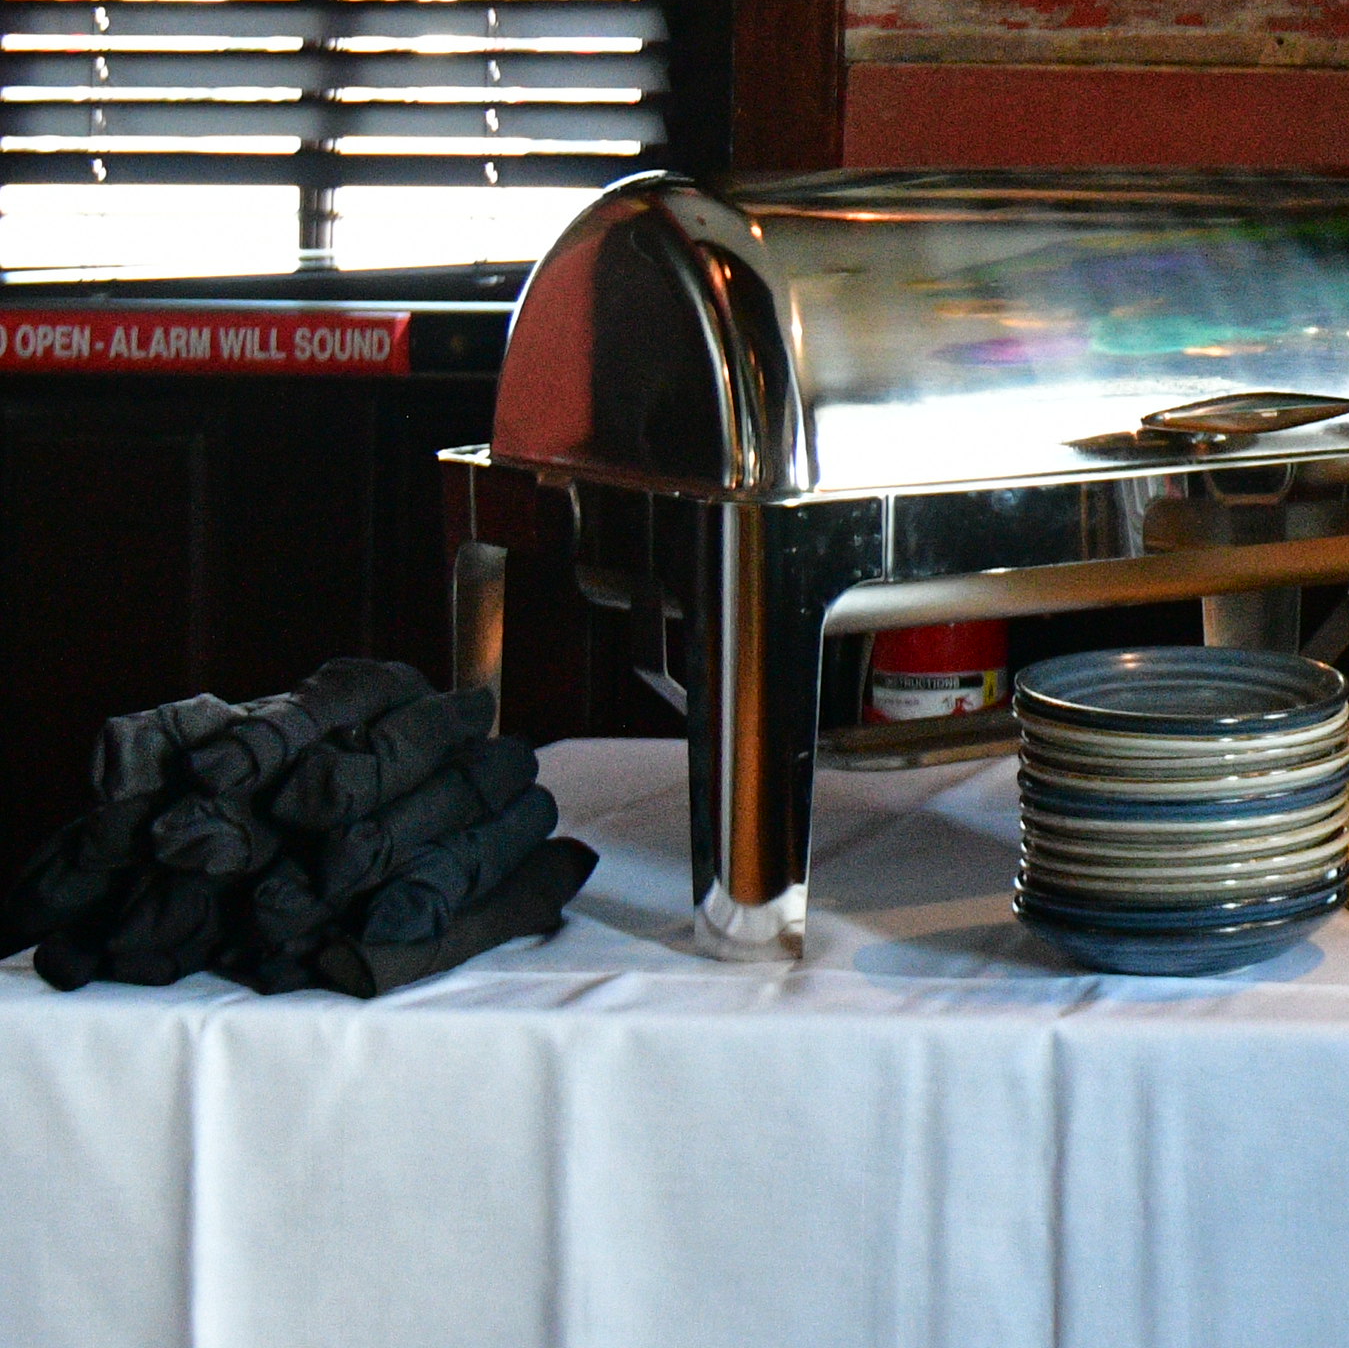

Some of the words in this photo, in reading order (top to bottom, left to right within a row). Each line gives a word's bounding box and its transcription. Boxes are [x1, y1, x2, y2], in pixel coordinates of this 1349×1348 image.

[109, 326, 211, 360] ALARM
[219, 327, 286, 361] WILL
[294, 327, 391, 361] SOUND
